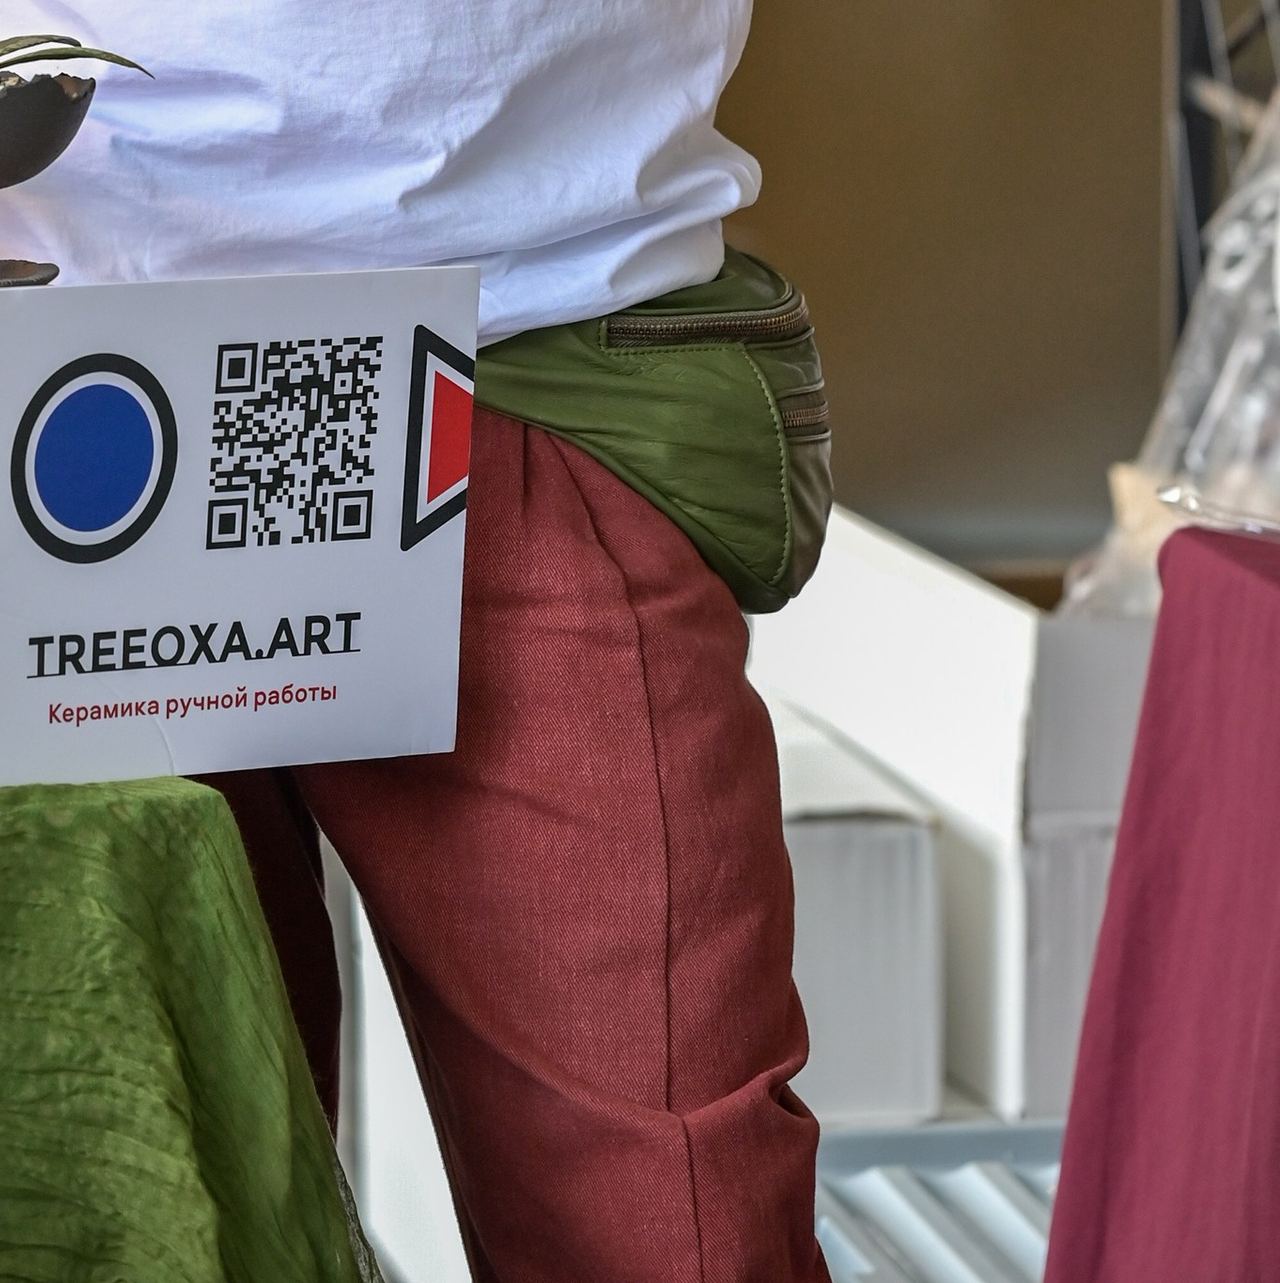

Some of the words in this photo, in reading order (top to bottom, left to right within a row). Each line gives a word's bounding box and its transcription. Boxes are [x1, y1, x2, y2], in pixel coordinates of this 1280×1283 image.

[27, 612, 362, 678] TREEOXA.ART
[48, 699, 160, 727] Керамика
[166, 686, 248, 719] ручной
[254, 683, 338, 712] работы
